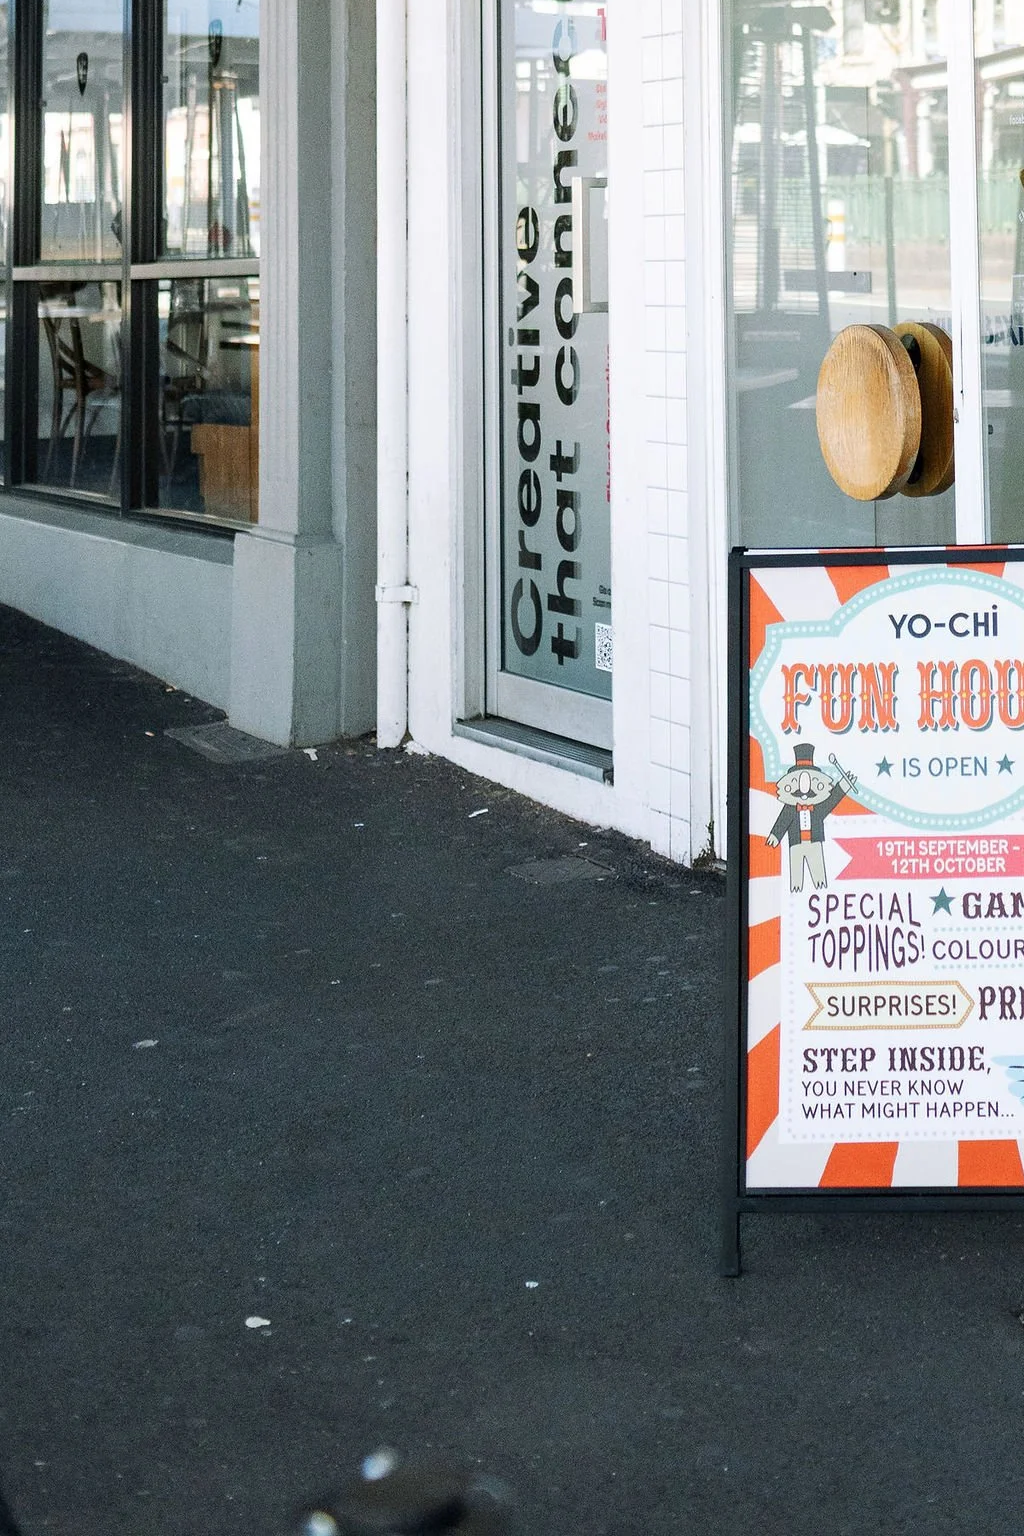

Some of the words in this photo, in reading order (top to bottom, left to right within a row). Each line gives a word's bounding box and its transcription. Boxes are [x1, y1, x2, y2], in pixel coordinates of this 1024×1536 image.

[508, 204, 544, 657] Creative
[549, 449, 583, 667] that
[780, 662, 900, 735] FUN
[901, 757, 922, 779] IS
[927, 756, 989, 778] OPEN
[876, 841, 916, 856] 19TH
[918, 839, 1010, 856] SEPTEMBER
[891, 858, 931, 874] 12TH
[933, 857, 1006, 874] OCTOBER
[808, 891, 922, 929] SPECIAL
[807, 924, 927, 972] TOPPINGS!
[826, 994, 958, 1018] SURPRISES!
[802, 1046, 877, 1074] STEP
[887, 1044, 993, 1076] INSIDE,
[801, 1079, 838, 1098] YOU
[843, 1079, 902, 1097] NEVER
[907, 1078, 965, 1097] KNOW
[801, 1102, 855, 1121] WHAT
[861, 1101, 921, 1120] MIGHT
[925, 1100, 1016, 1120] HAPPEN...
